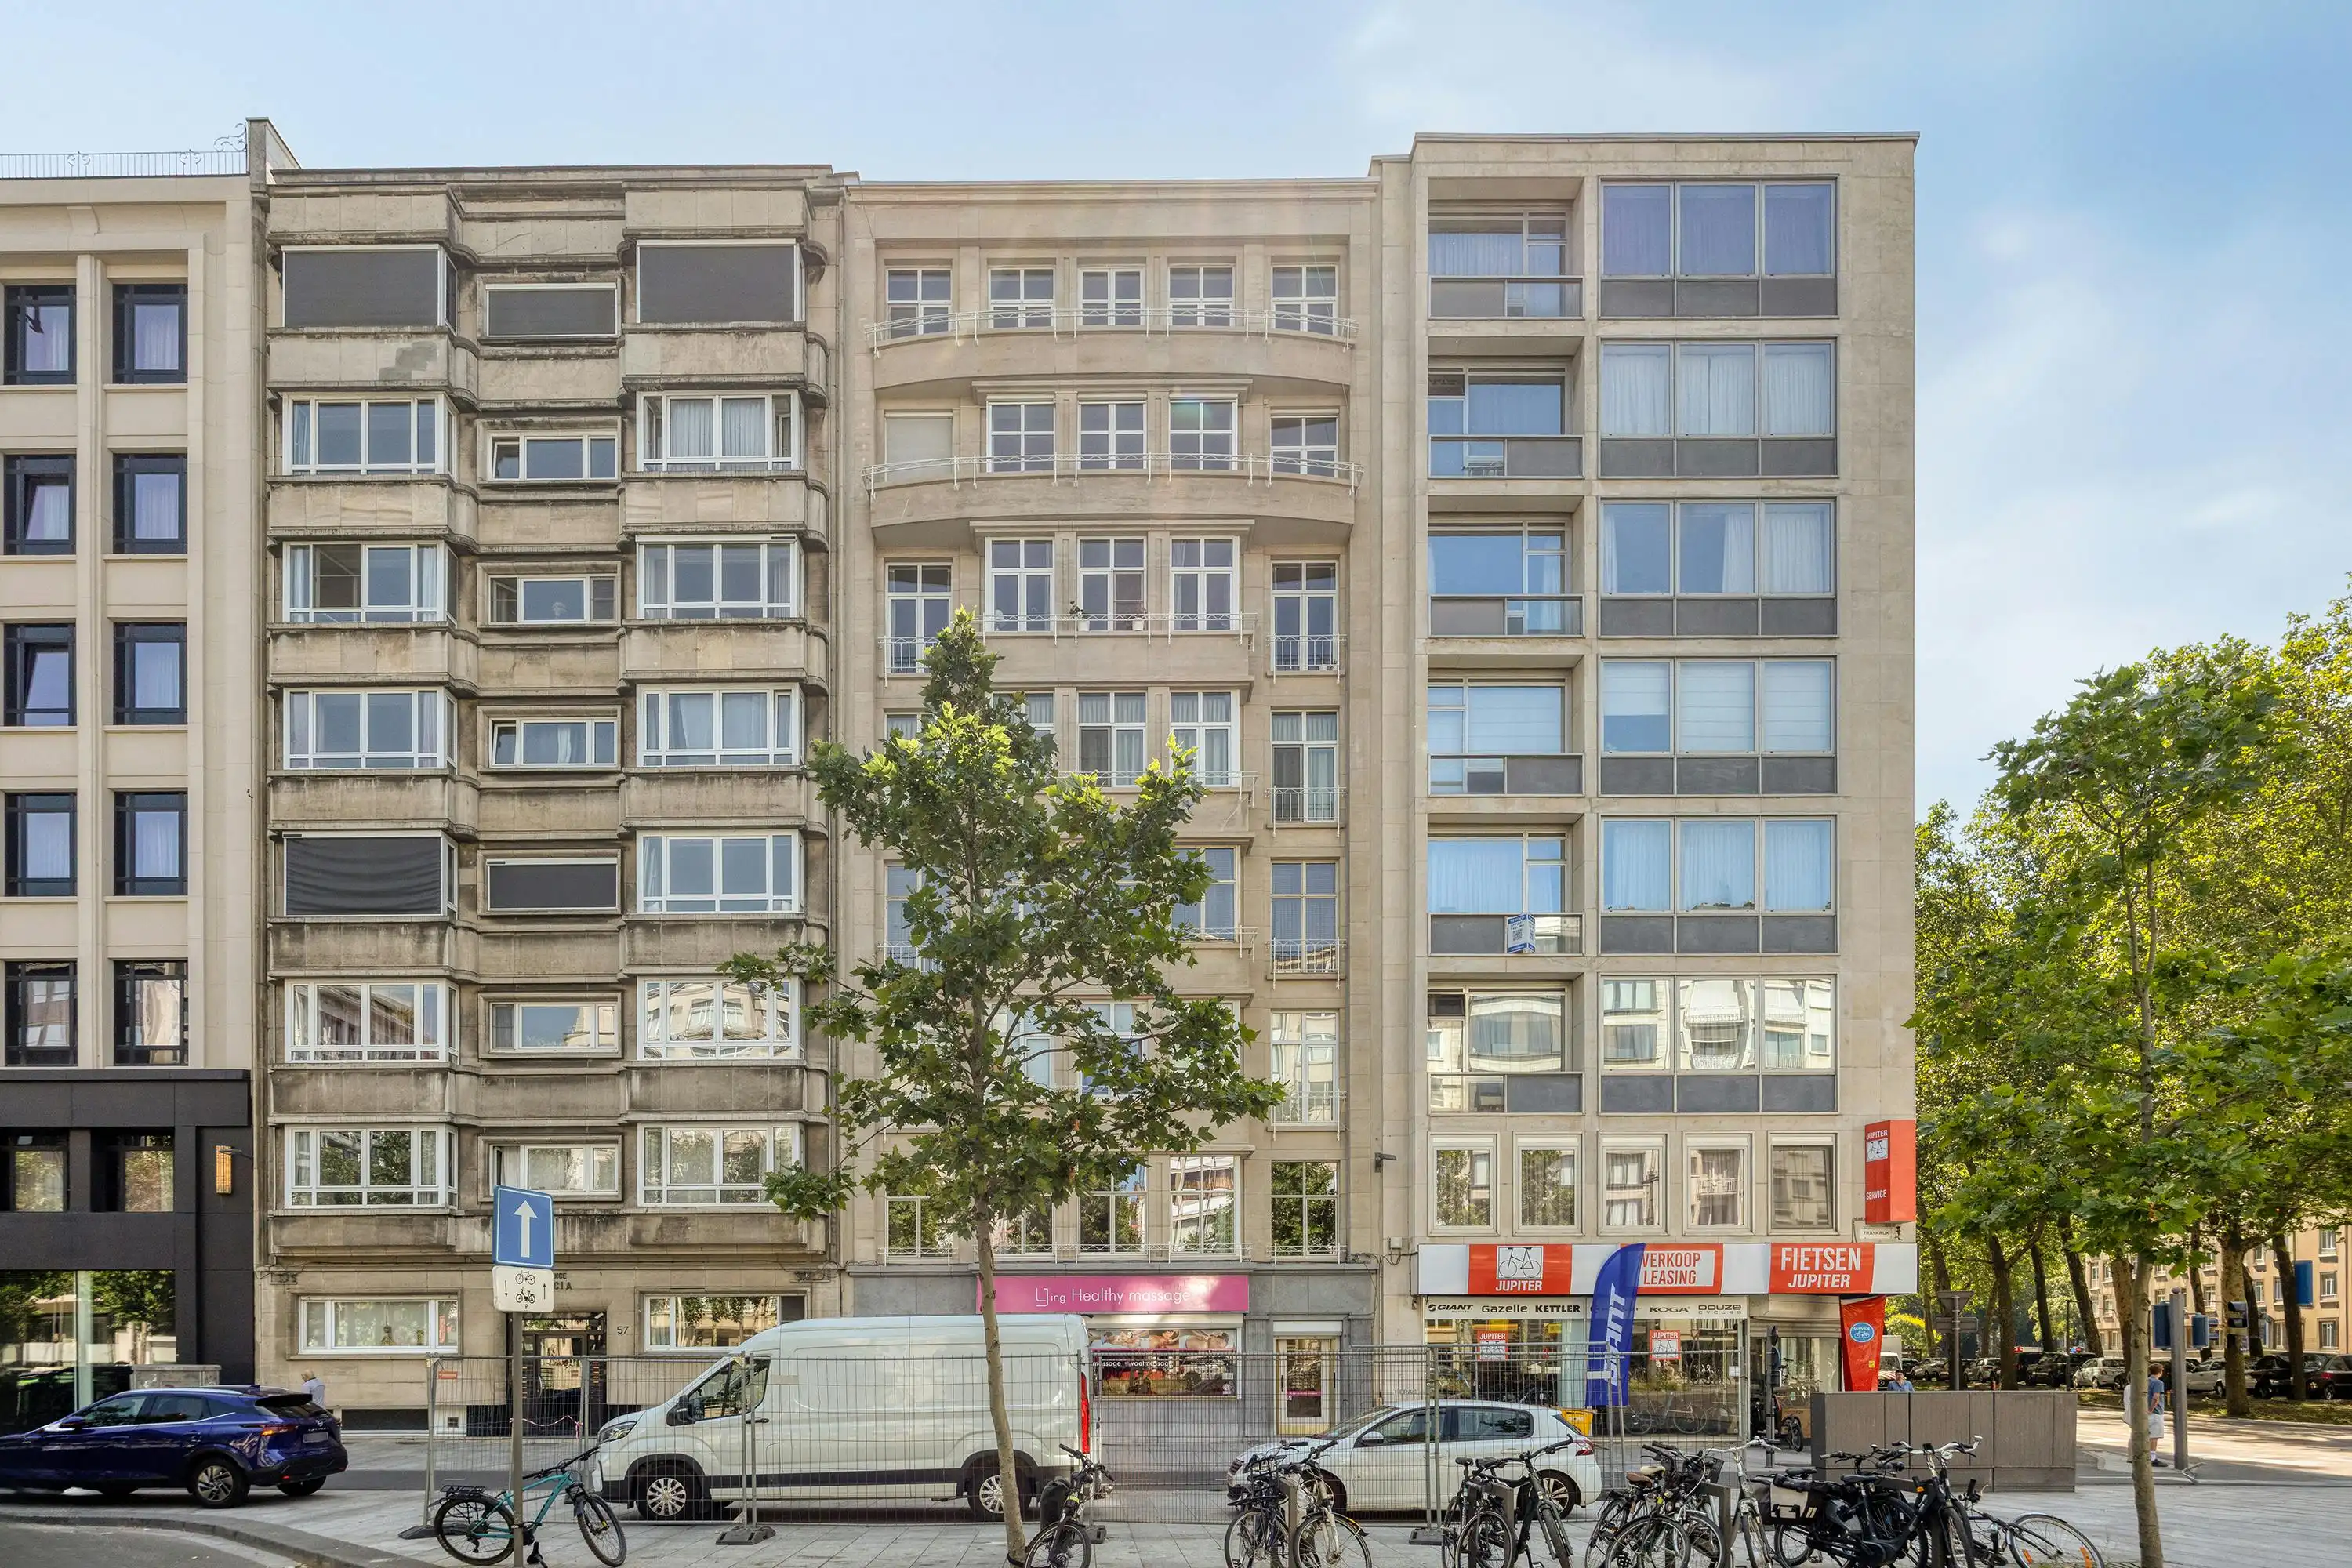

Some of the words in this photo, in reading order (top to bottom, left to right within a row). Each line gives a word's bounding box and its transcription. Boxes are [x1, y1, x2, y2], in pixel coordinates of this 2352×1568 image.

[1866, 1129, 1888, 1140] JUPITER
[1866, 1189, 1887, 1200] SERVICE
[1642, 1253, 1700, 1268] VERKOOP
[1780, 1247, 1861, 1271] FIETSEN
[1644, 1270, 1697, 1285] LEASING
[1788, 1274, 1850, 1288] JUPITER
[1496, 1280, 1542, 1291] JUPITER
[1072, 1287, 1123, 1305] Healthy
[1129, 1292, 1191, 1305] massage
[1482, 1304, 1528, 1313] Gazelle
[616, 1326, 629, 1334] 57
